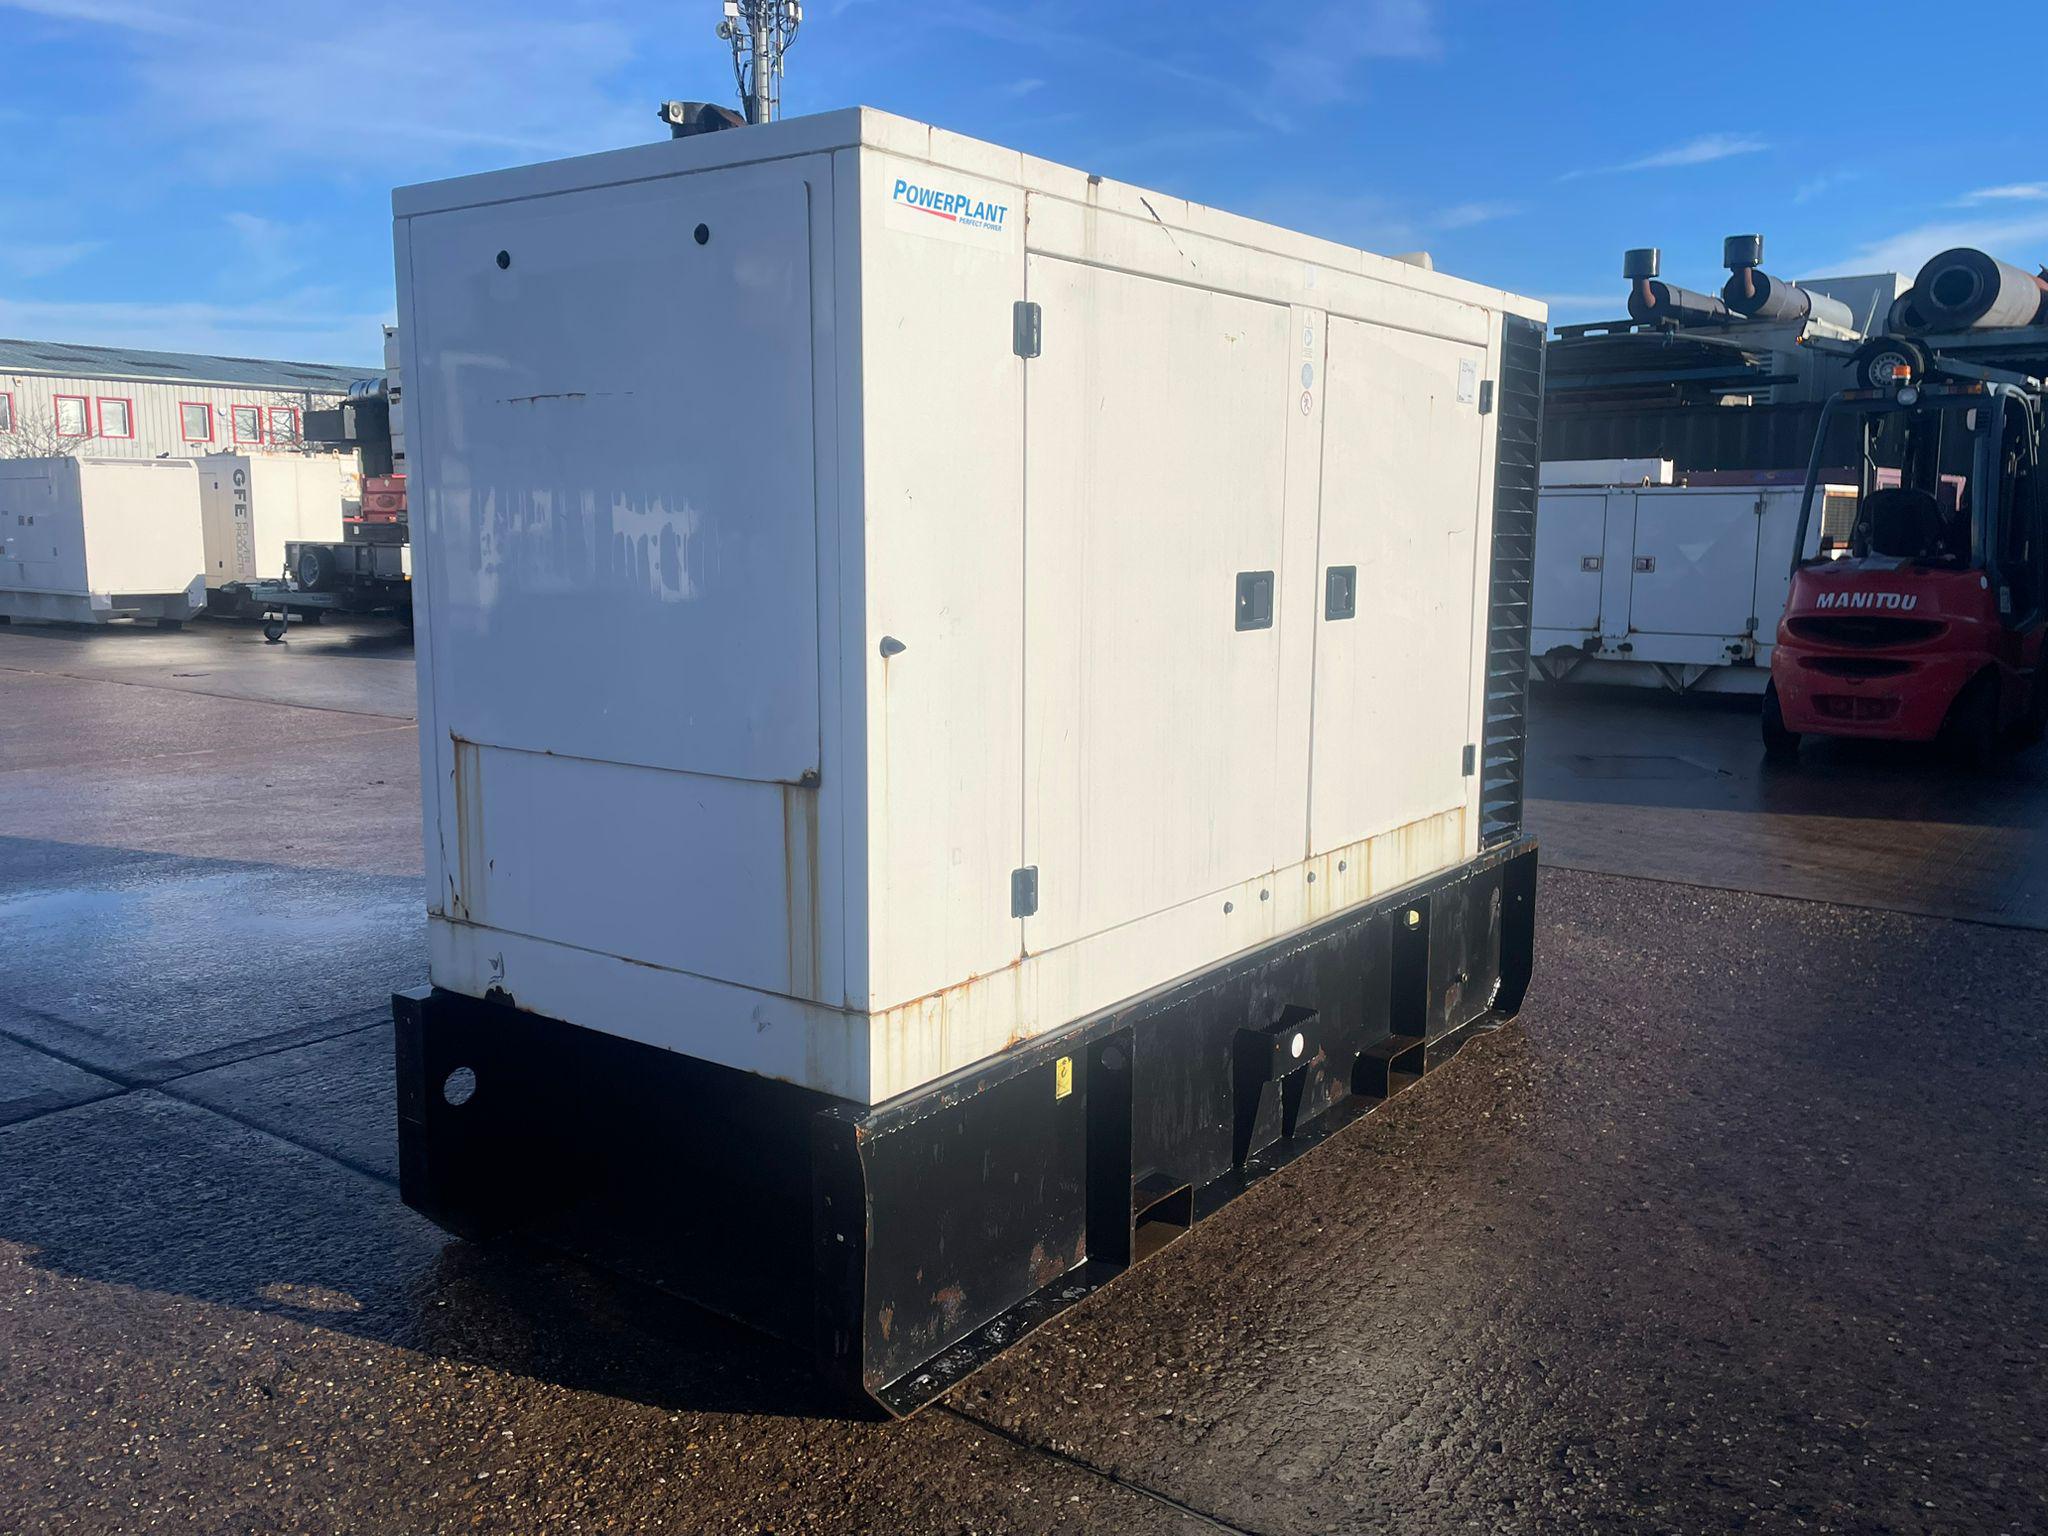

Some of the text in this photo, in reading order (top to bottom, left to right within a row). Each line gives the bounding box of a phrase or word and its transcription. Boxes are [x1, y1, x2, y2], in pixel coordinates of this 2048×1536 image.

[893, 179, 1008, 223] POWERPLANT
[959, 217, 1002, 232] PERFECT POWER
[232, 468, 247, 518] GFE
[1816, 592, 1917, 611] MANITOU
